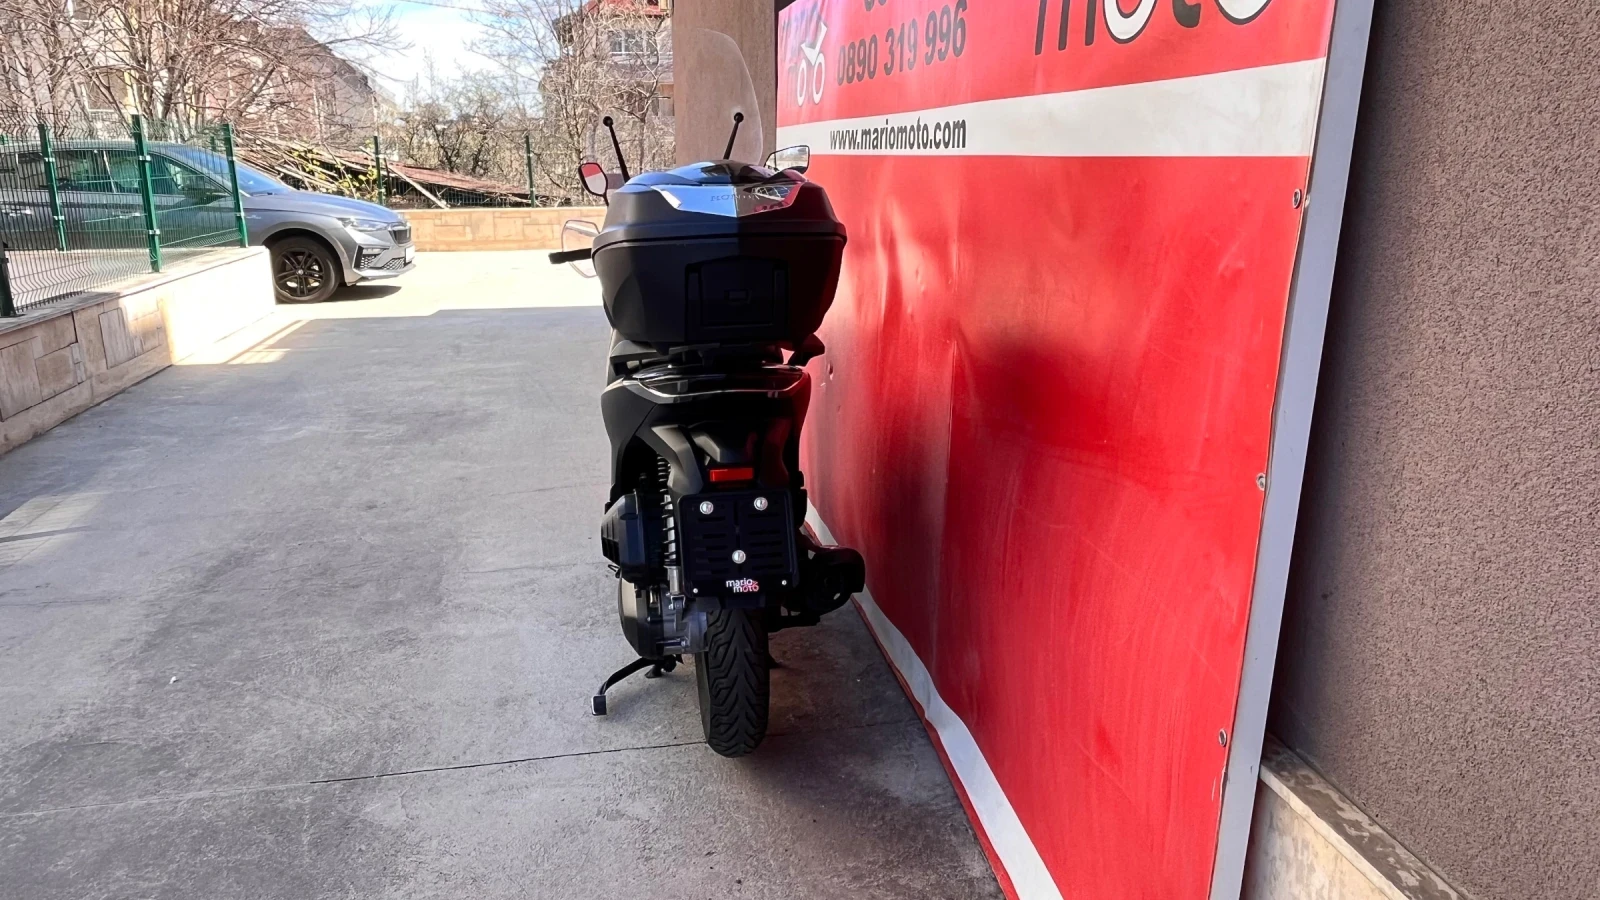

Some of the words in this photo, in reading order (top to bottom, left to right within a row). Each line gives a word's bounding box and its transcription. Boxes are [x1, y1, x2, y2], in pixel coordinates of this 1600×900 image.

[838, 35, 878, 86] 0890
[884, 18, 918, 75] 319
[925, 0, 967, 65] 996
[830, 116, 966, 150] www.mariomoto.com
[726, 578, 753, 588] mario
[733, 584, 759, 593] moto
